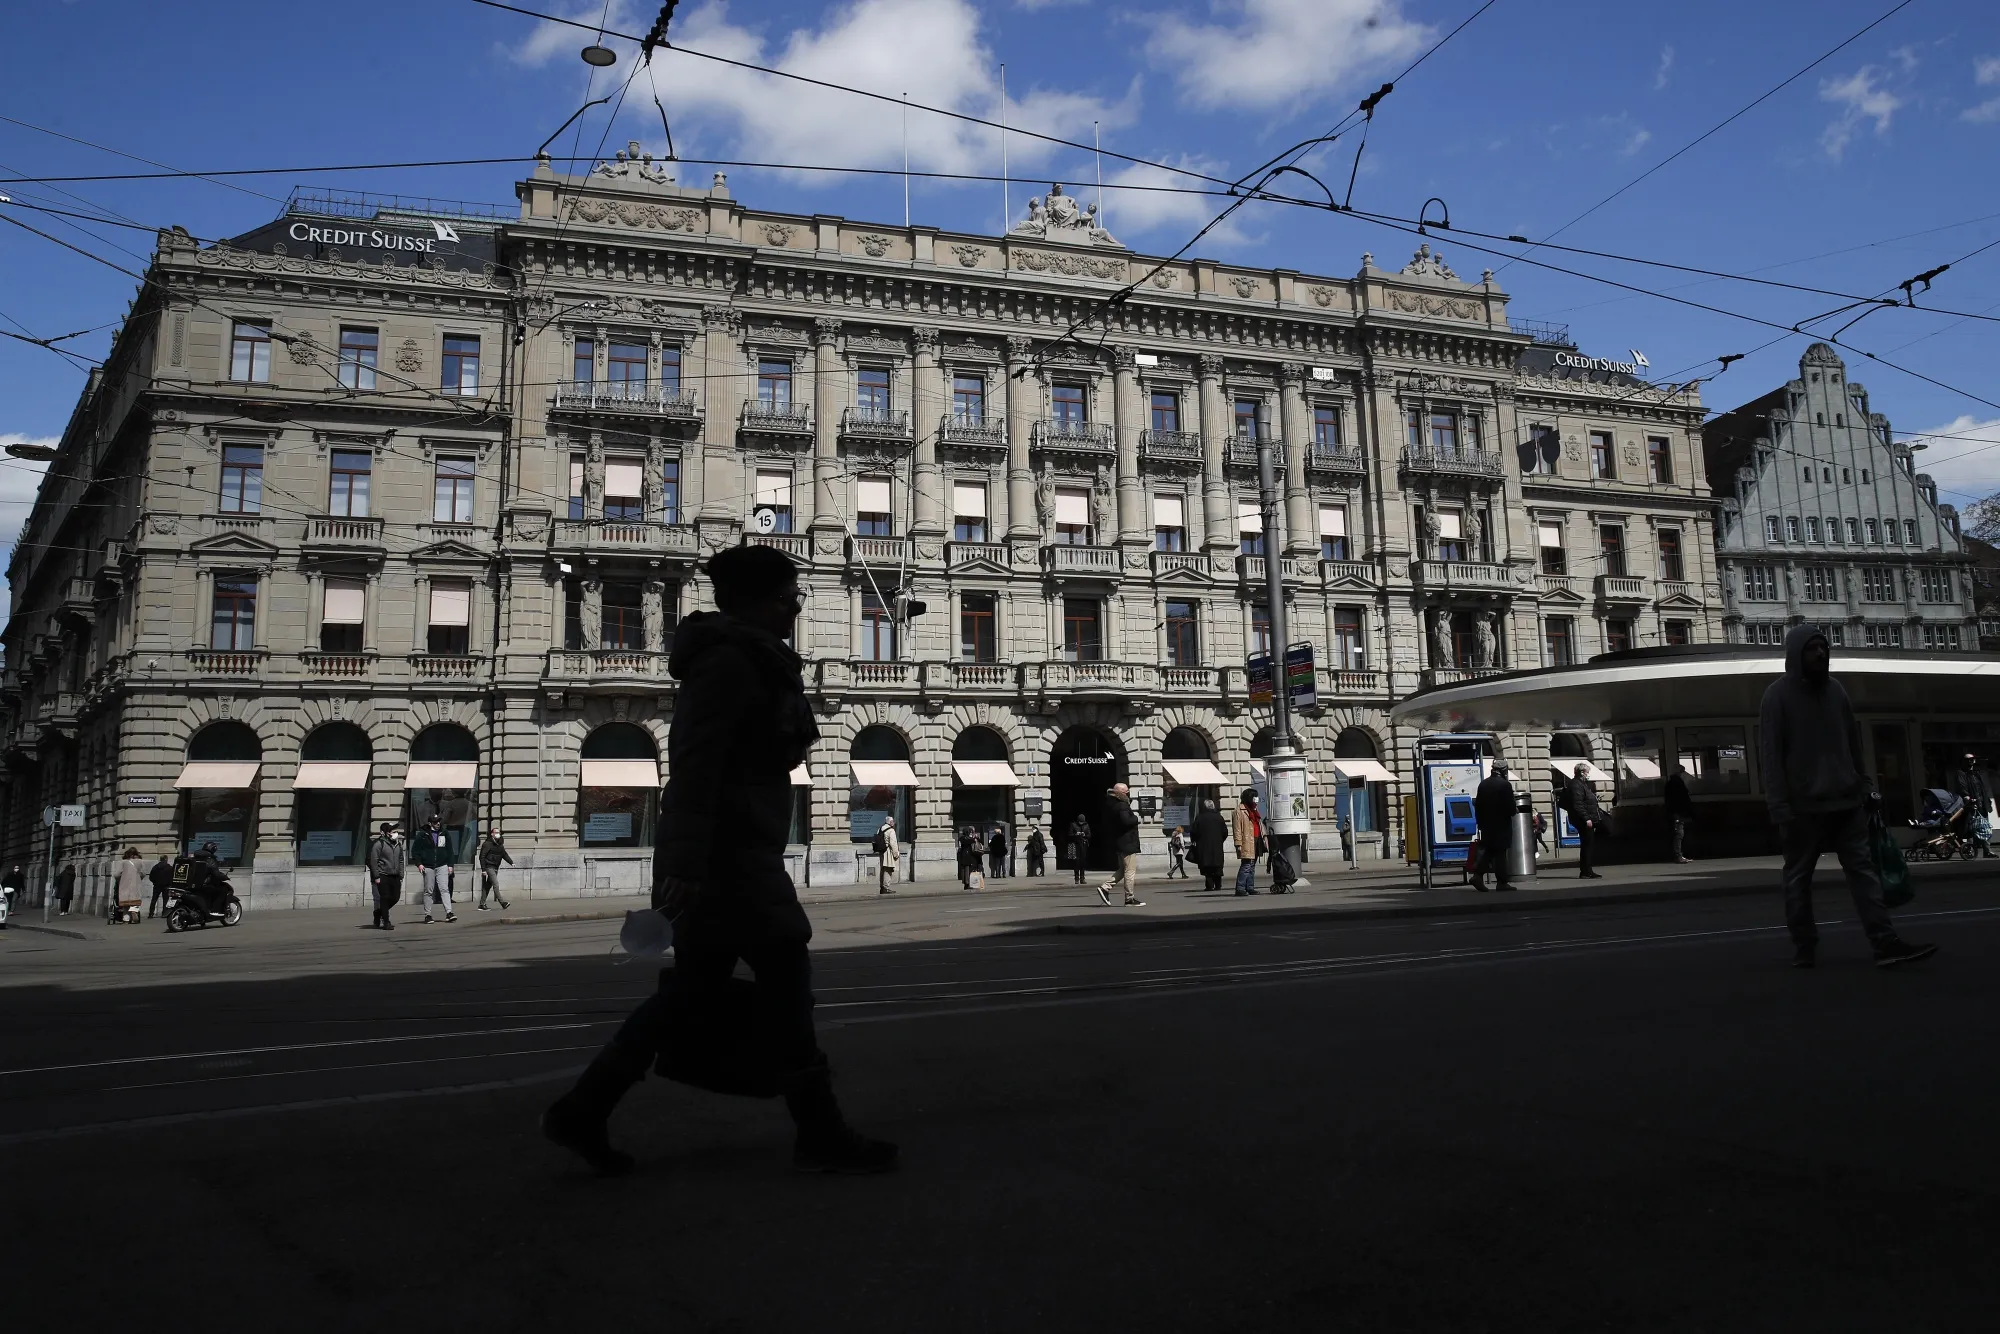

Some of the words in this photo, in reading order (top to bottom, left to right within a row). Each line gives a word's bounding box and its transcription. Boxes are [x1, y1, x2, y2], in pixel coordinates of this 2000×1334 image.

[289, 222, 368, 246] CREDIT
[370, 230, 436, 253] SUISSE
[1555, 351, 1600, 370] CREDIT
[1600, 357, 1639, 374] SUISSE
[758, 514, 772, 527] 15
[1064, 756, 1088, 764] CREDIT
